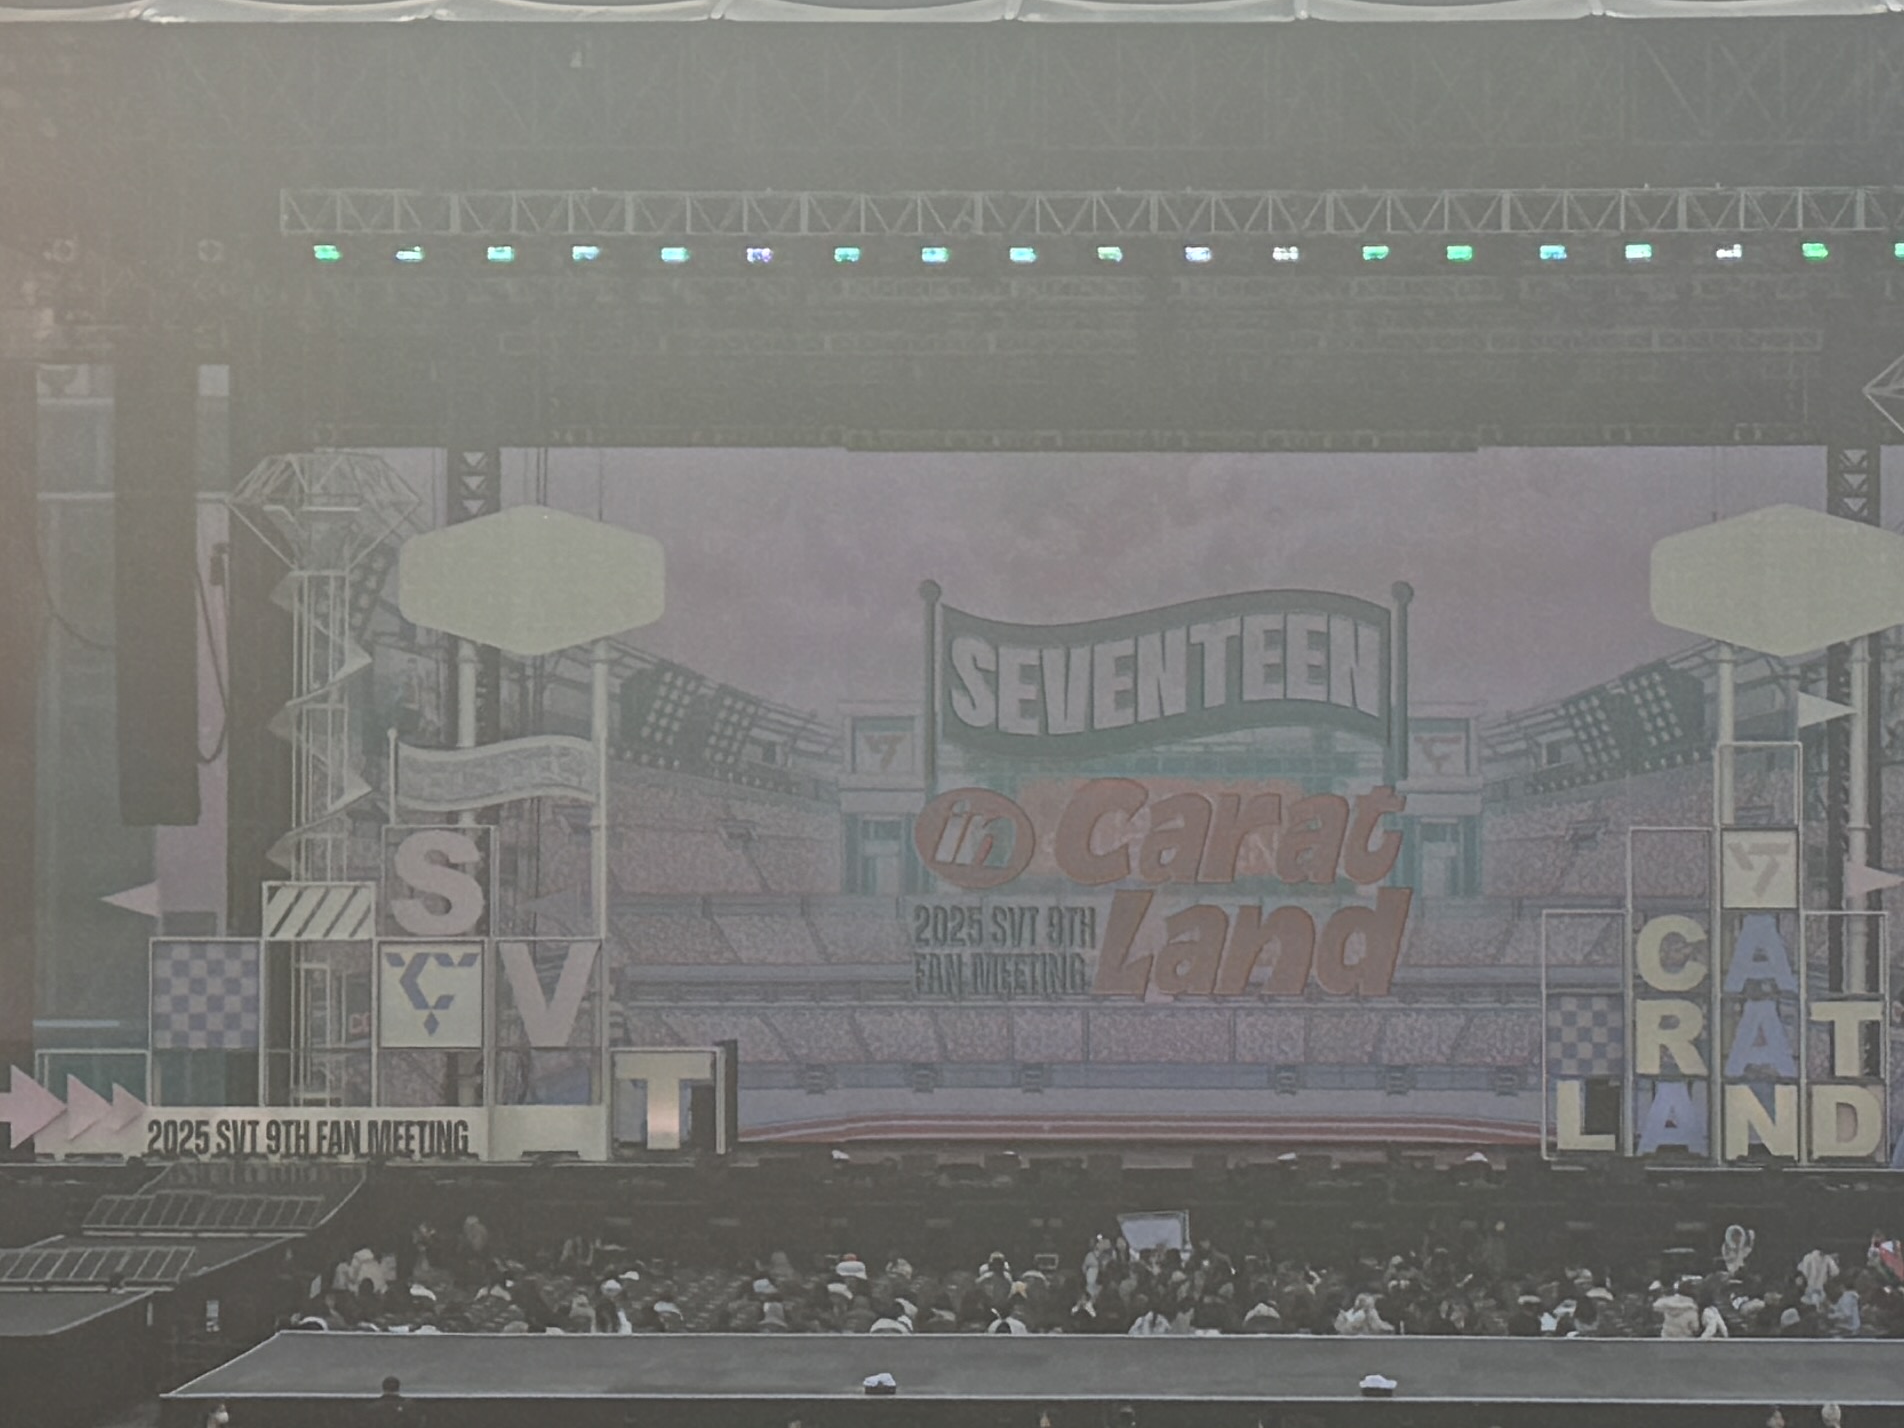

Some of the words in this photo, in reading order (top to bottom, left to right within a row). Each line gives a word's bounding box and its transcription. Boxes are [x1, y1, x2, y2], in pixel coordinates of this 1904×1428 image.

[948, 612, 1381, 735] SEVENTEEN
[934, 796, 1018, 869] in
[1054, 778, 1406, 884] Carat
[913, 903, 983, 947] 2025
[992, 905, 1040, 948] SVT
[1047, 905, 1096, 950] 9TH
[1095, 886, 1412, 996] Land
[914, 952, 963, 995] FAN
[971, 952, 1086, 995] MEETING
[147, 1119, 210, 1156] 2025
[215, 1119, 260, 1156] SVT
[265, 1119, 310, 1157] 9TH
[316, 1119, 361, 1157] FAN
[367, 1119, 470, 1158] MEETING
